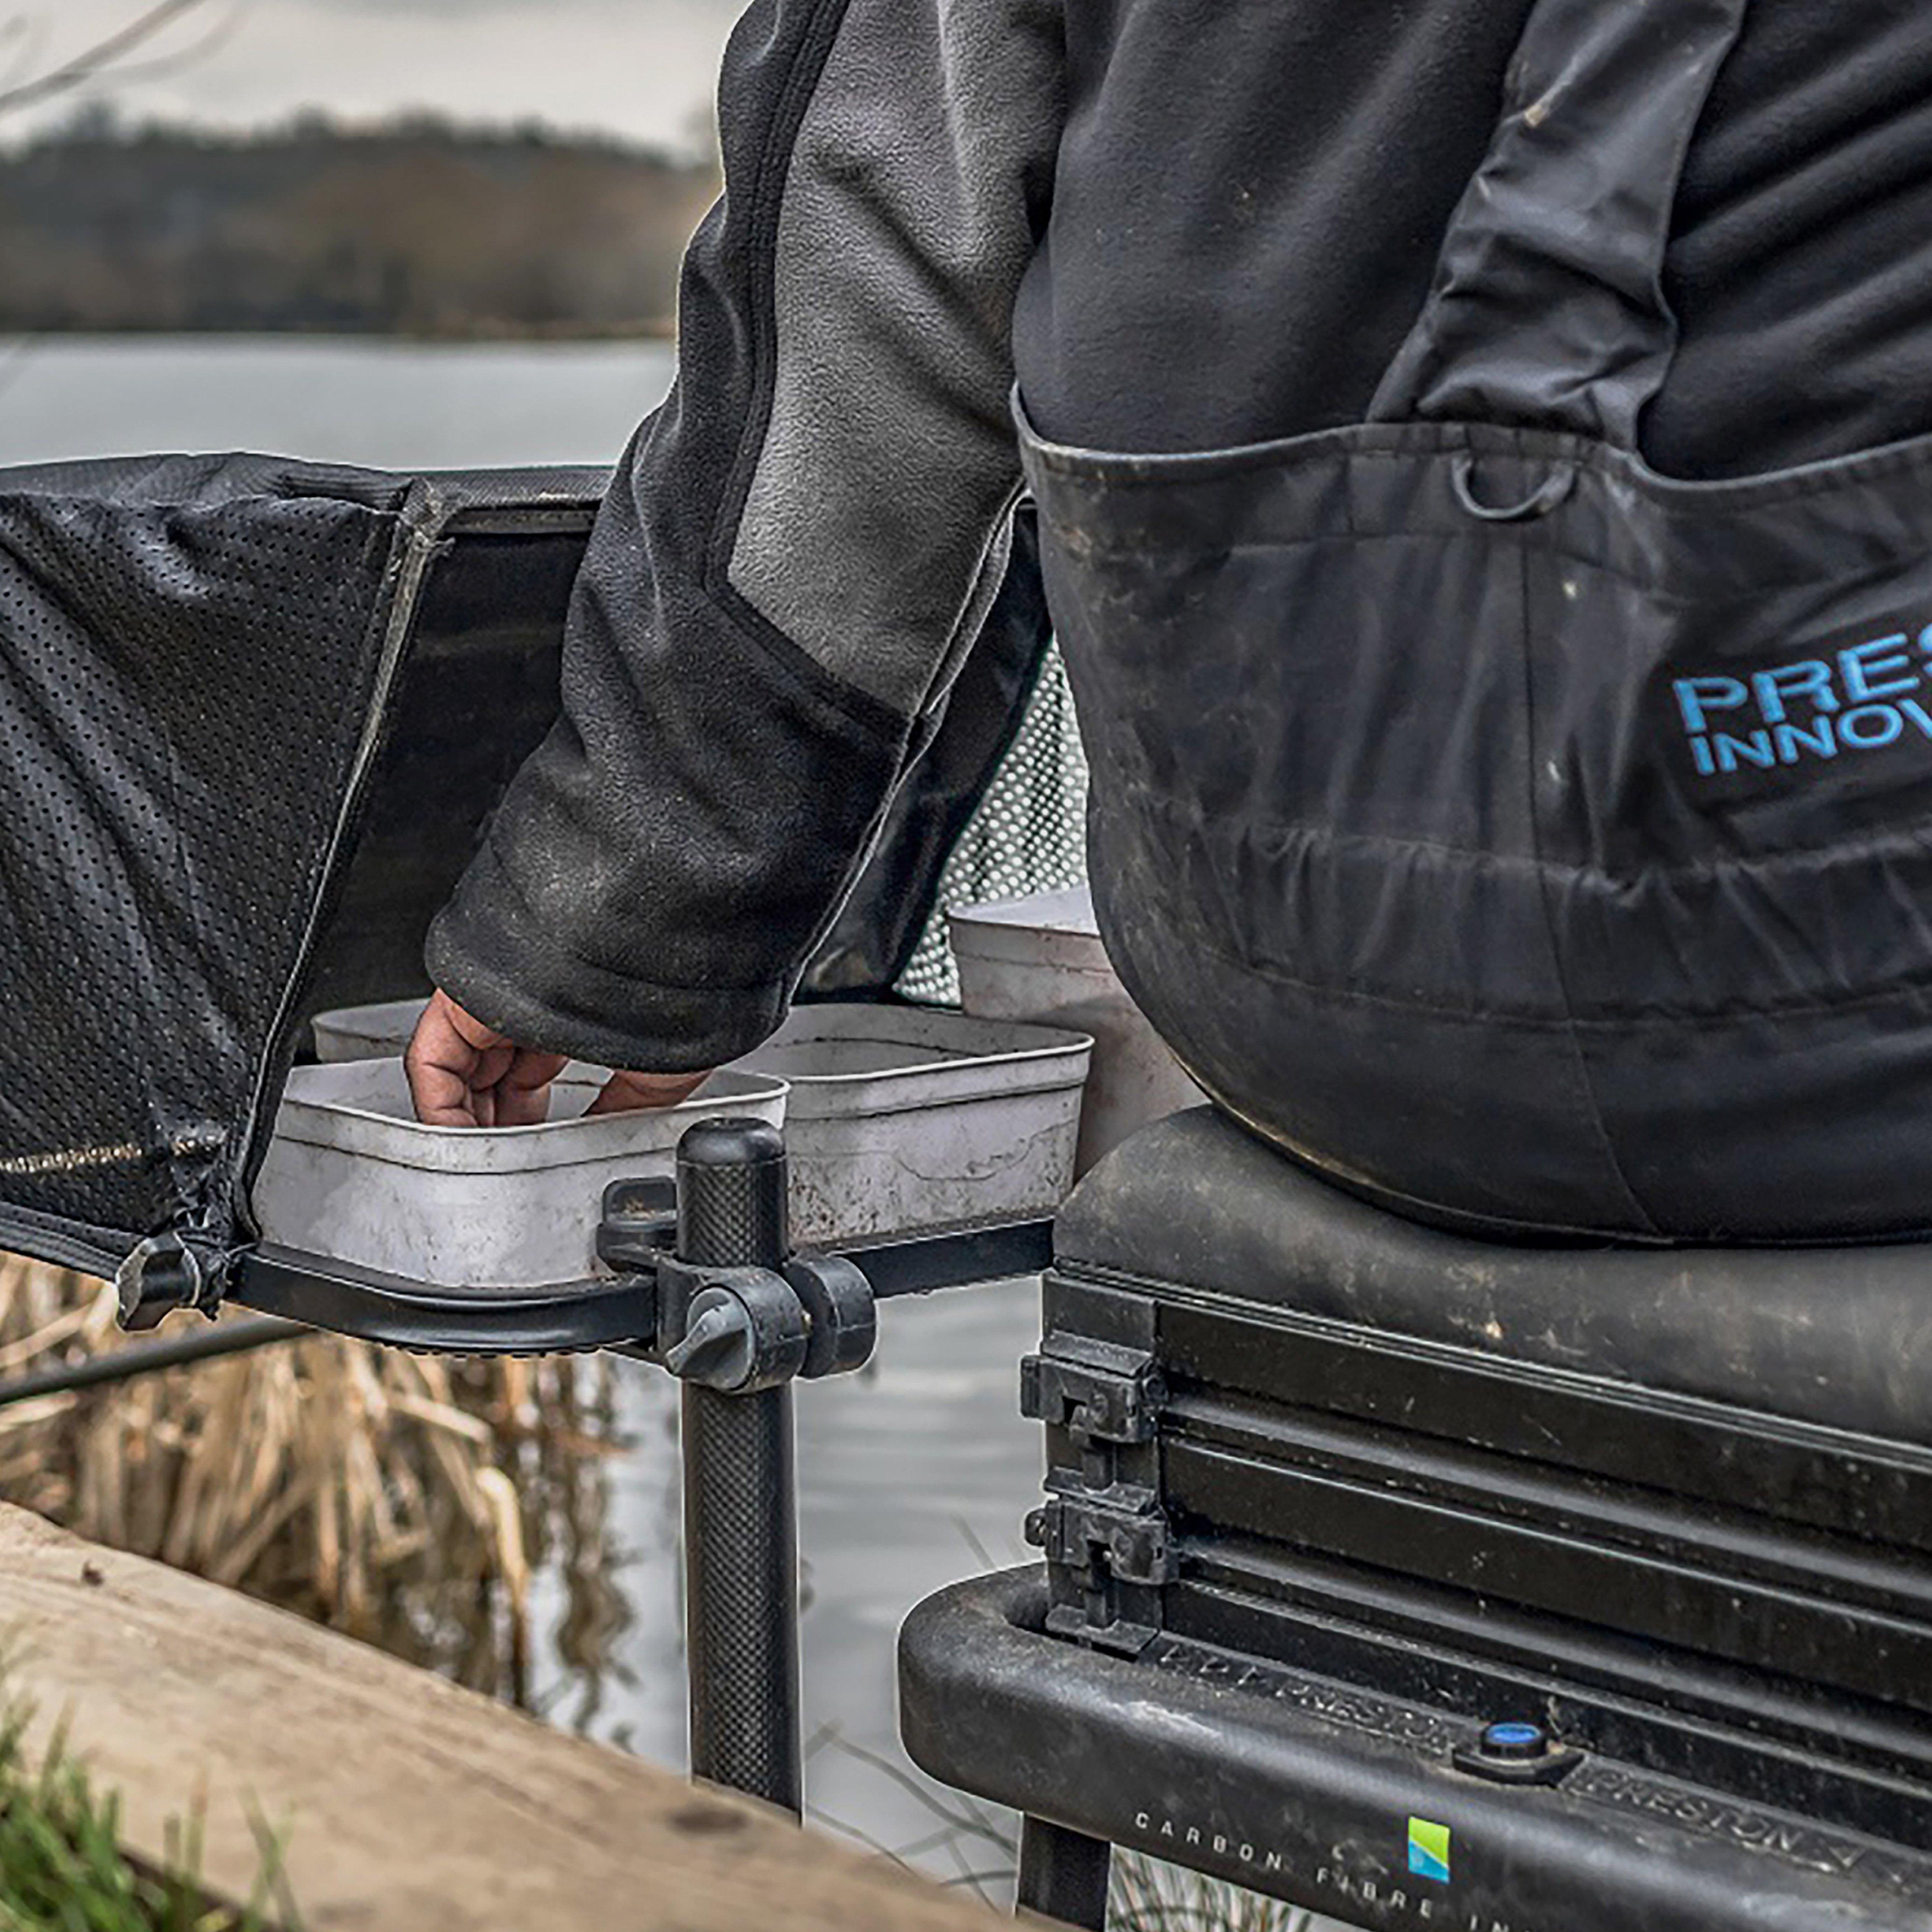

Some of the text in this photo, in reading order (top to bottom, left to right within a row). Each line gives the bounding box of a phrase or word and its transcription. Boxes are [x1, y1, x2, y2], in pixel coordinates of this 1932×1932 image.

[1673, 623, 1932, 733] PRE
[1135, 1812, 1530, 1932] CARBON FIBRE IN
